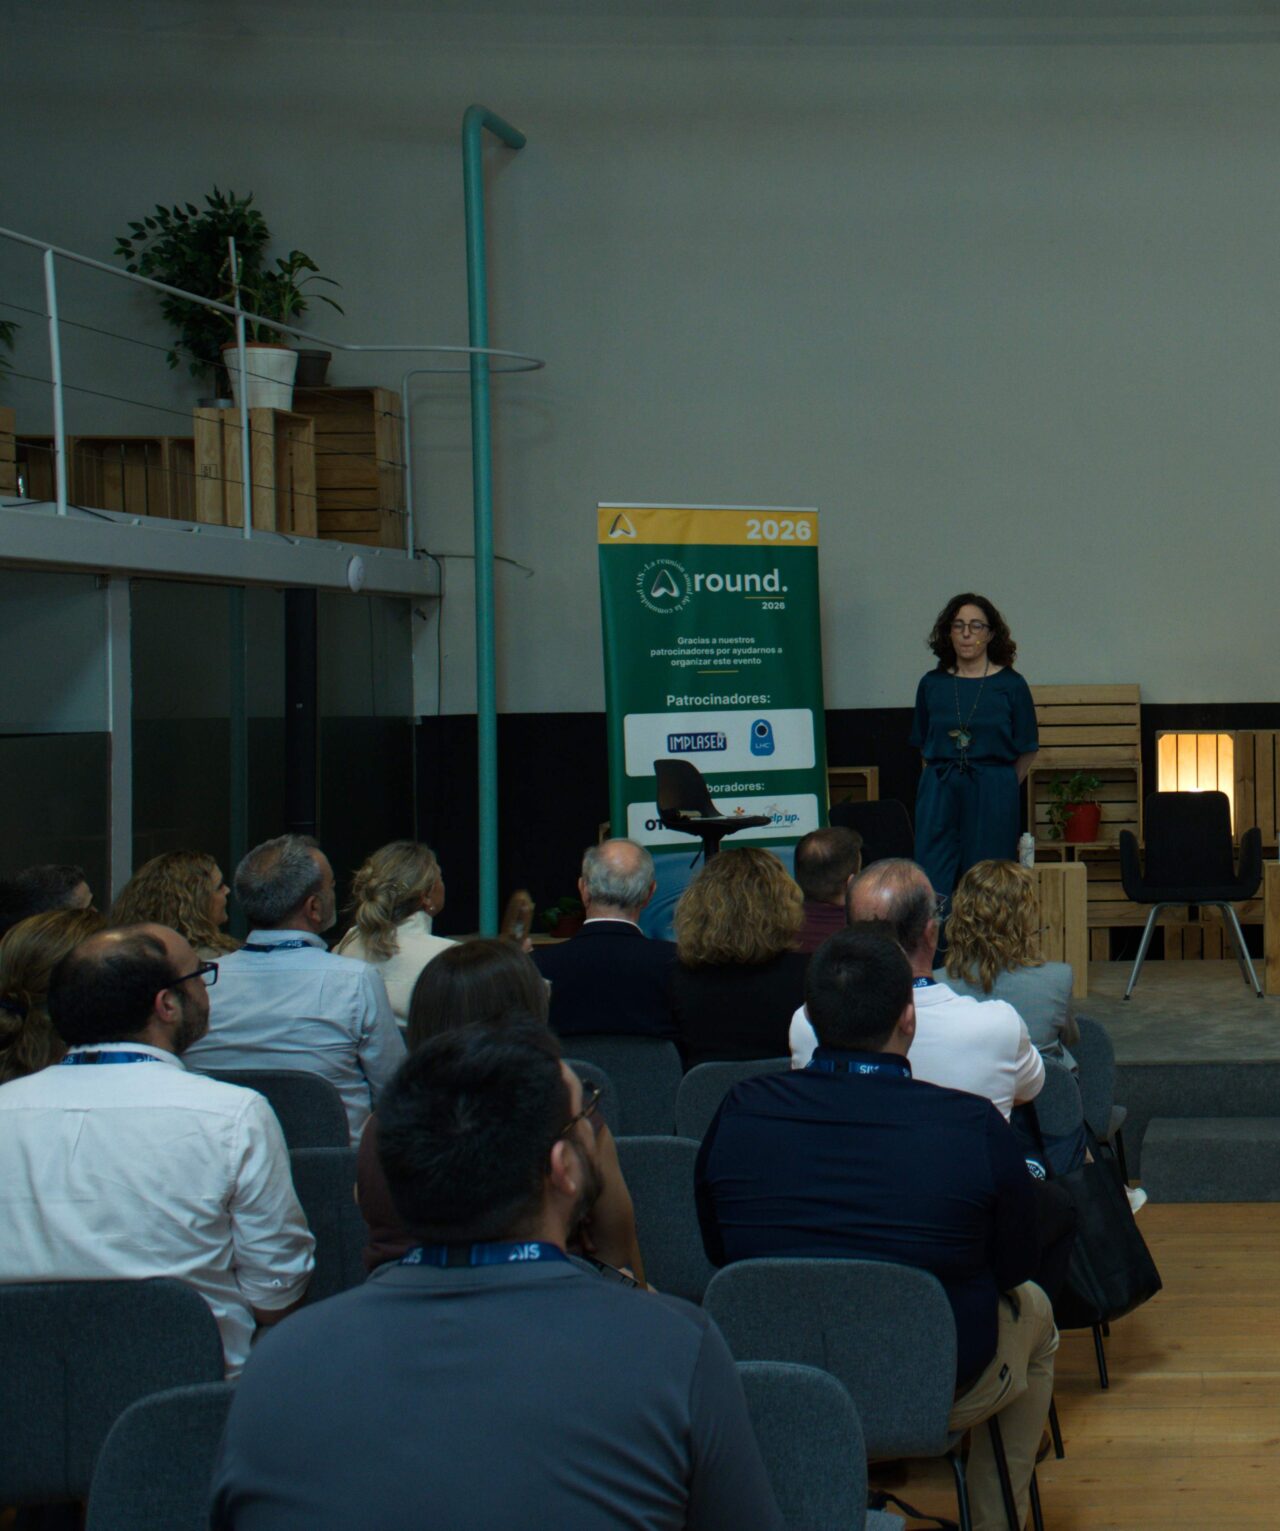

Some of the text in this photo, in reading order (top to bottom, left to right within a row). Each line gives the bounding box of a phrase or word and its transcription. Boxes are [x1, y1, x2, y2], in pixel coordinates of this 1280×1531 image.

[746, 519, 811, 541] 2026
[694, 568, 788, 592] round.
[677, 636, 710, 645] Gracias
[719, 636, 755, 644] nuestros
[650, 647, 715, 658] patrocinadores
[716, 648, 731, 656] por
[732, 646, 775, 656] ayudarnos
[670, 657, 711, 668] organizar
[733, 657, 762, 665] evento
[666, 693, 771, 706] Patrocinadores:
[670, 734, 724, 751] IMPLASER
[706, 781, 765, 793] boradores:
[508, 1243, 541, 1262] AIS
